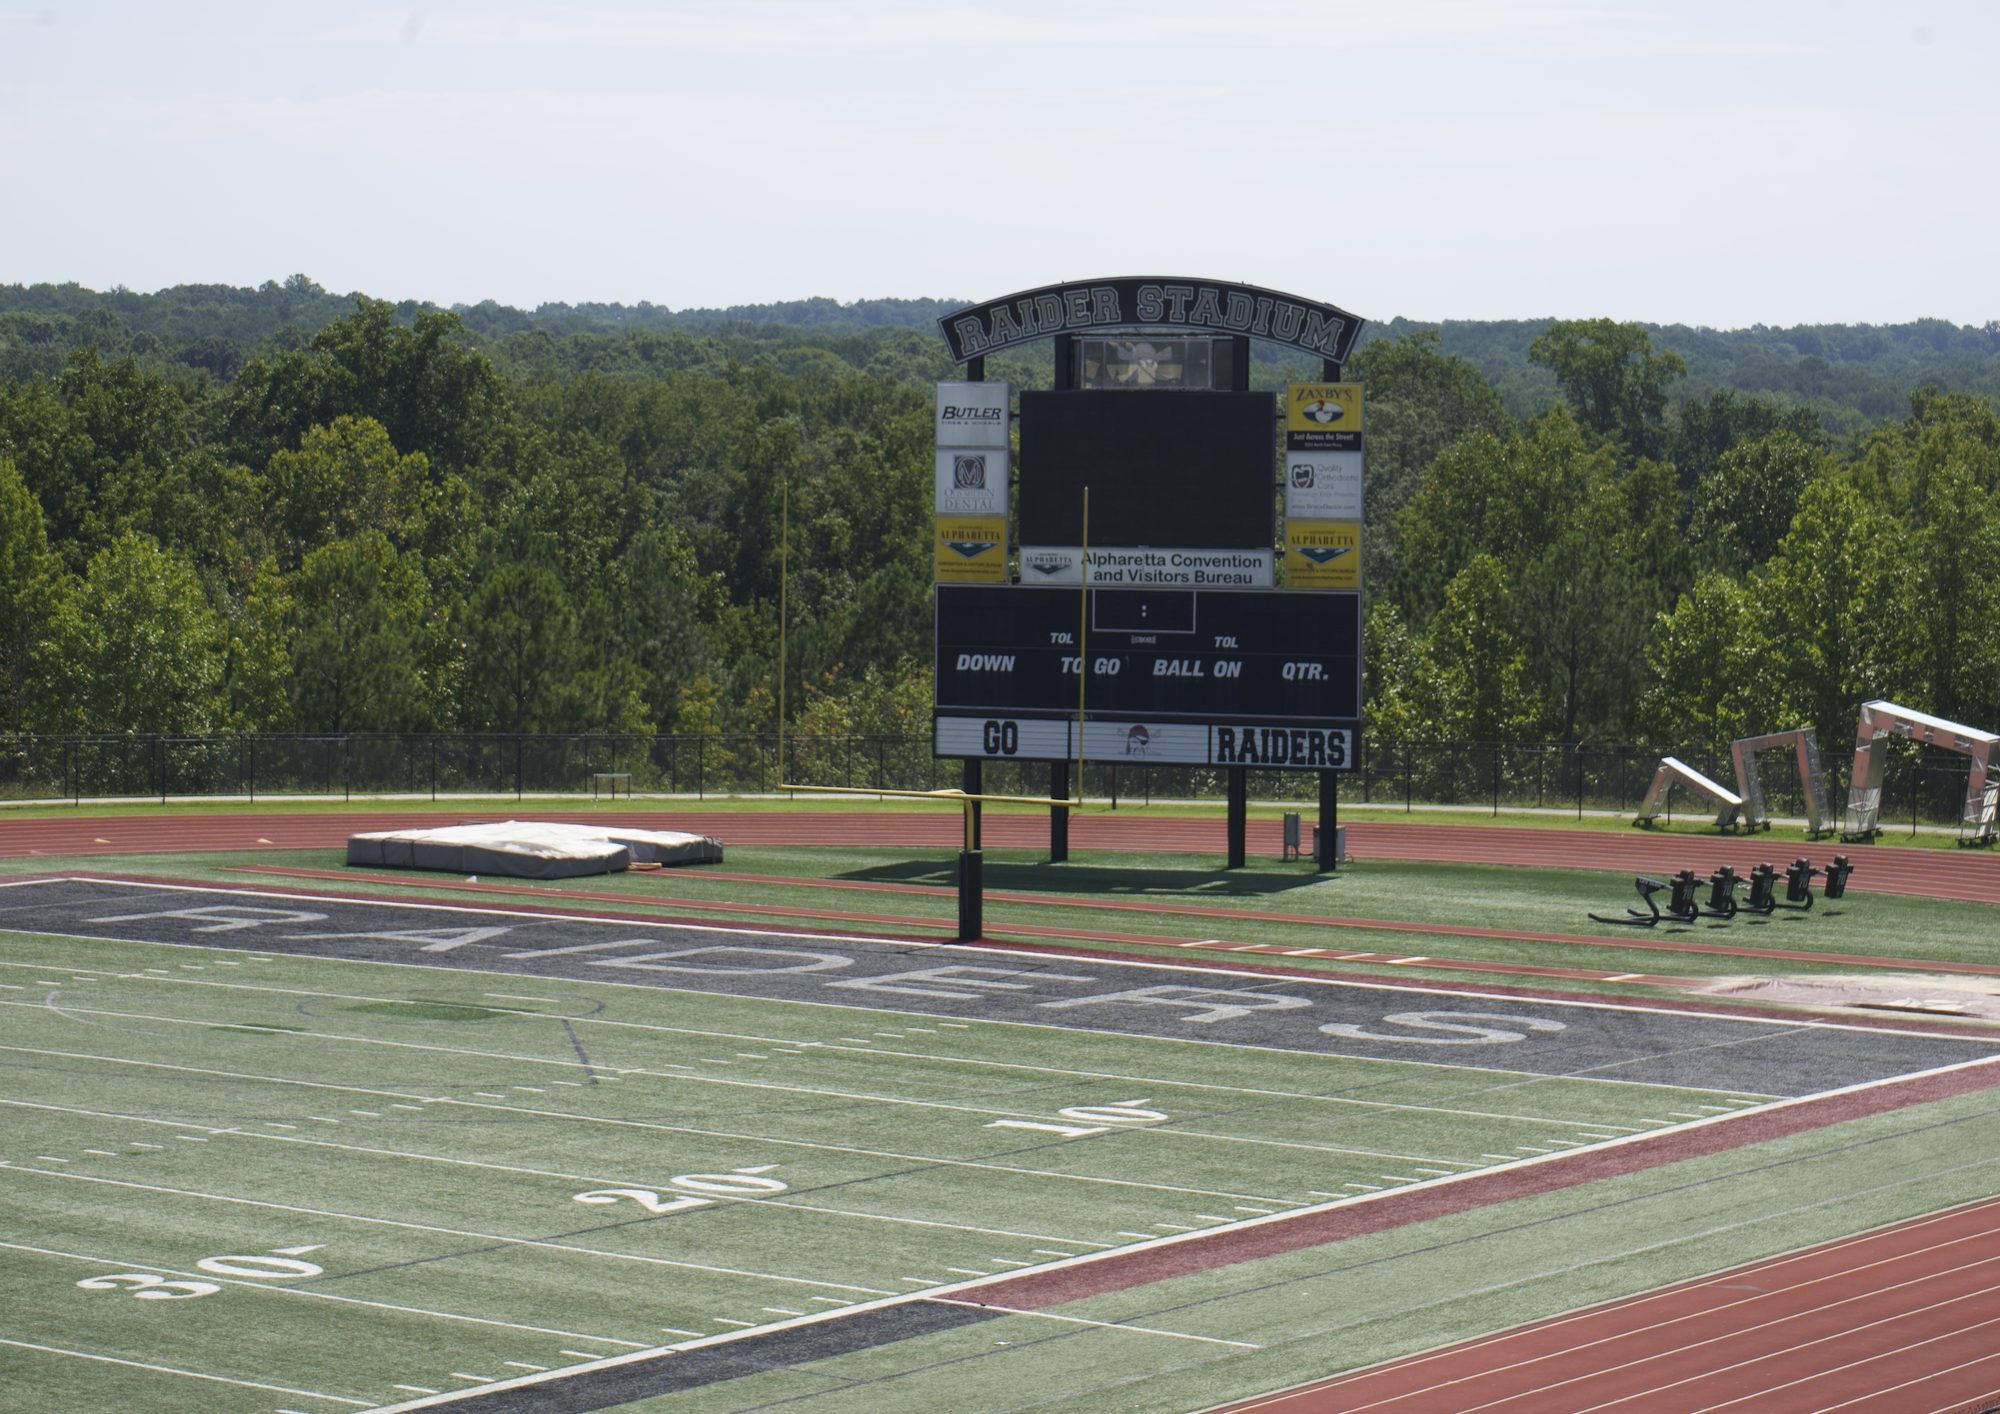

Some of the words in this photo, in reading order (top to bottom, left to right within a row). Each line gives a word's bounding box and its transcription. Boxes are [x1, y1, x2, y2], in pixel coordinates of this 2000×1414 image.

[954, 287, 1121, 356] RAIDER
[1137, 285, 1345, 356] STADIUM
[1295, 387, 1353, 402] ZAXBY'S
[942, 405, 1002, 420] BUTLER
[944, 498, 993, 509] DENTAL
[941, 530, 1001, 540] ALPHARETTA
[1291, 535, 1354, 545] ALPHARETTA
[1081, 552, 1166, 568] Alpharetta
[1171, 553, 1262, 568] Convention
[1094, 569, 1123, 581] and
[1128, 568, 1189, 583] Visitors
[1194, 570, 1252, 584] Bureau
[1050, 632, 1074, 644] TOL
[1214, 636, 1238, 648] TOL
[956, 654, 1016, 672] DOWN
[1094, 657, 1121, 675] GO
[1152, 659, 1204, 677] BALL
[1213, 660, 1241, 678] ON
[1282, 662, 1329, 681] QTR.
[984, 720, 1018, 755] GO
[1217, 727, 1345, 767] RAIDERS
[983, 1104, 1168, 1137] 10
[572, 1170, 788, 1214] 20
[75, 1253, 324, 1301] 30
